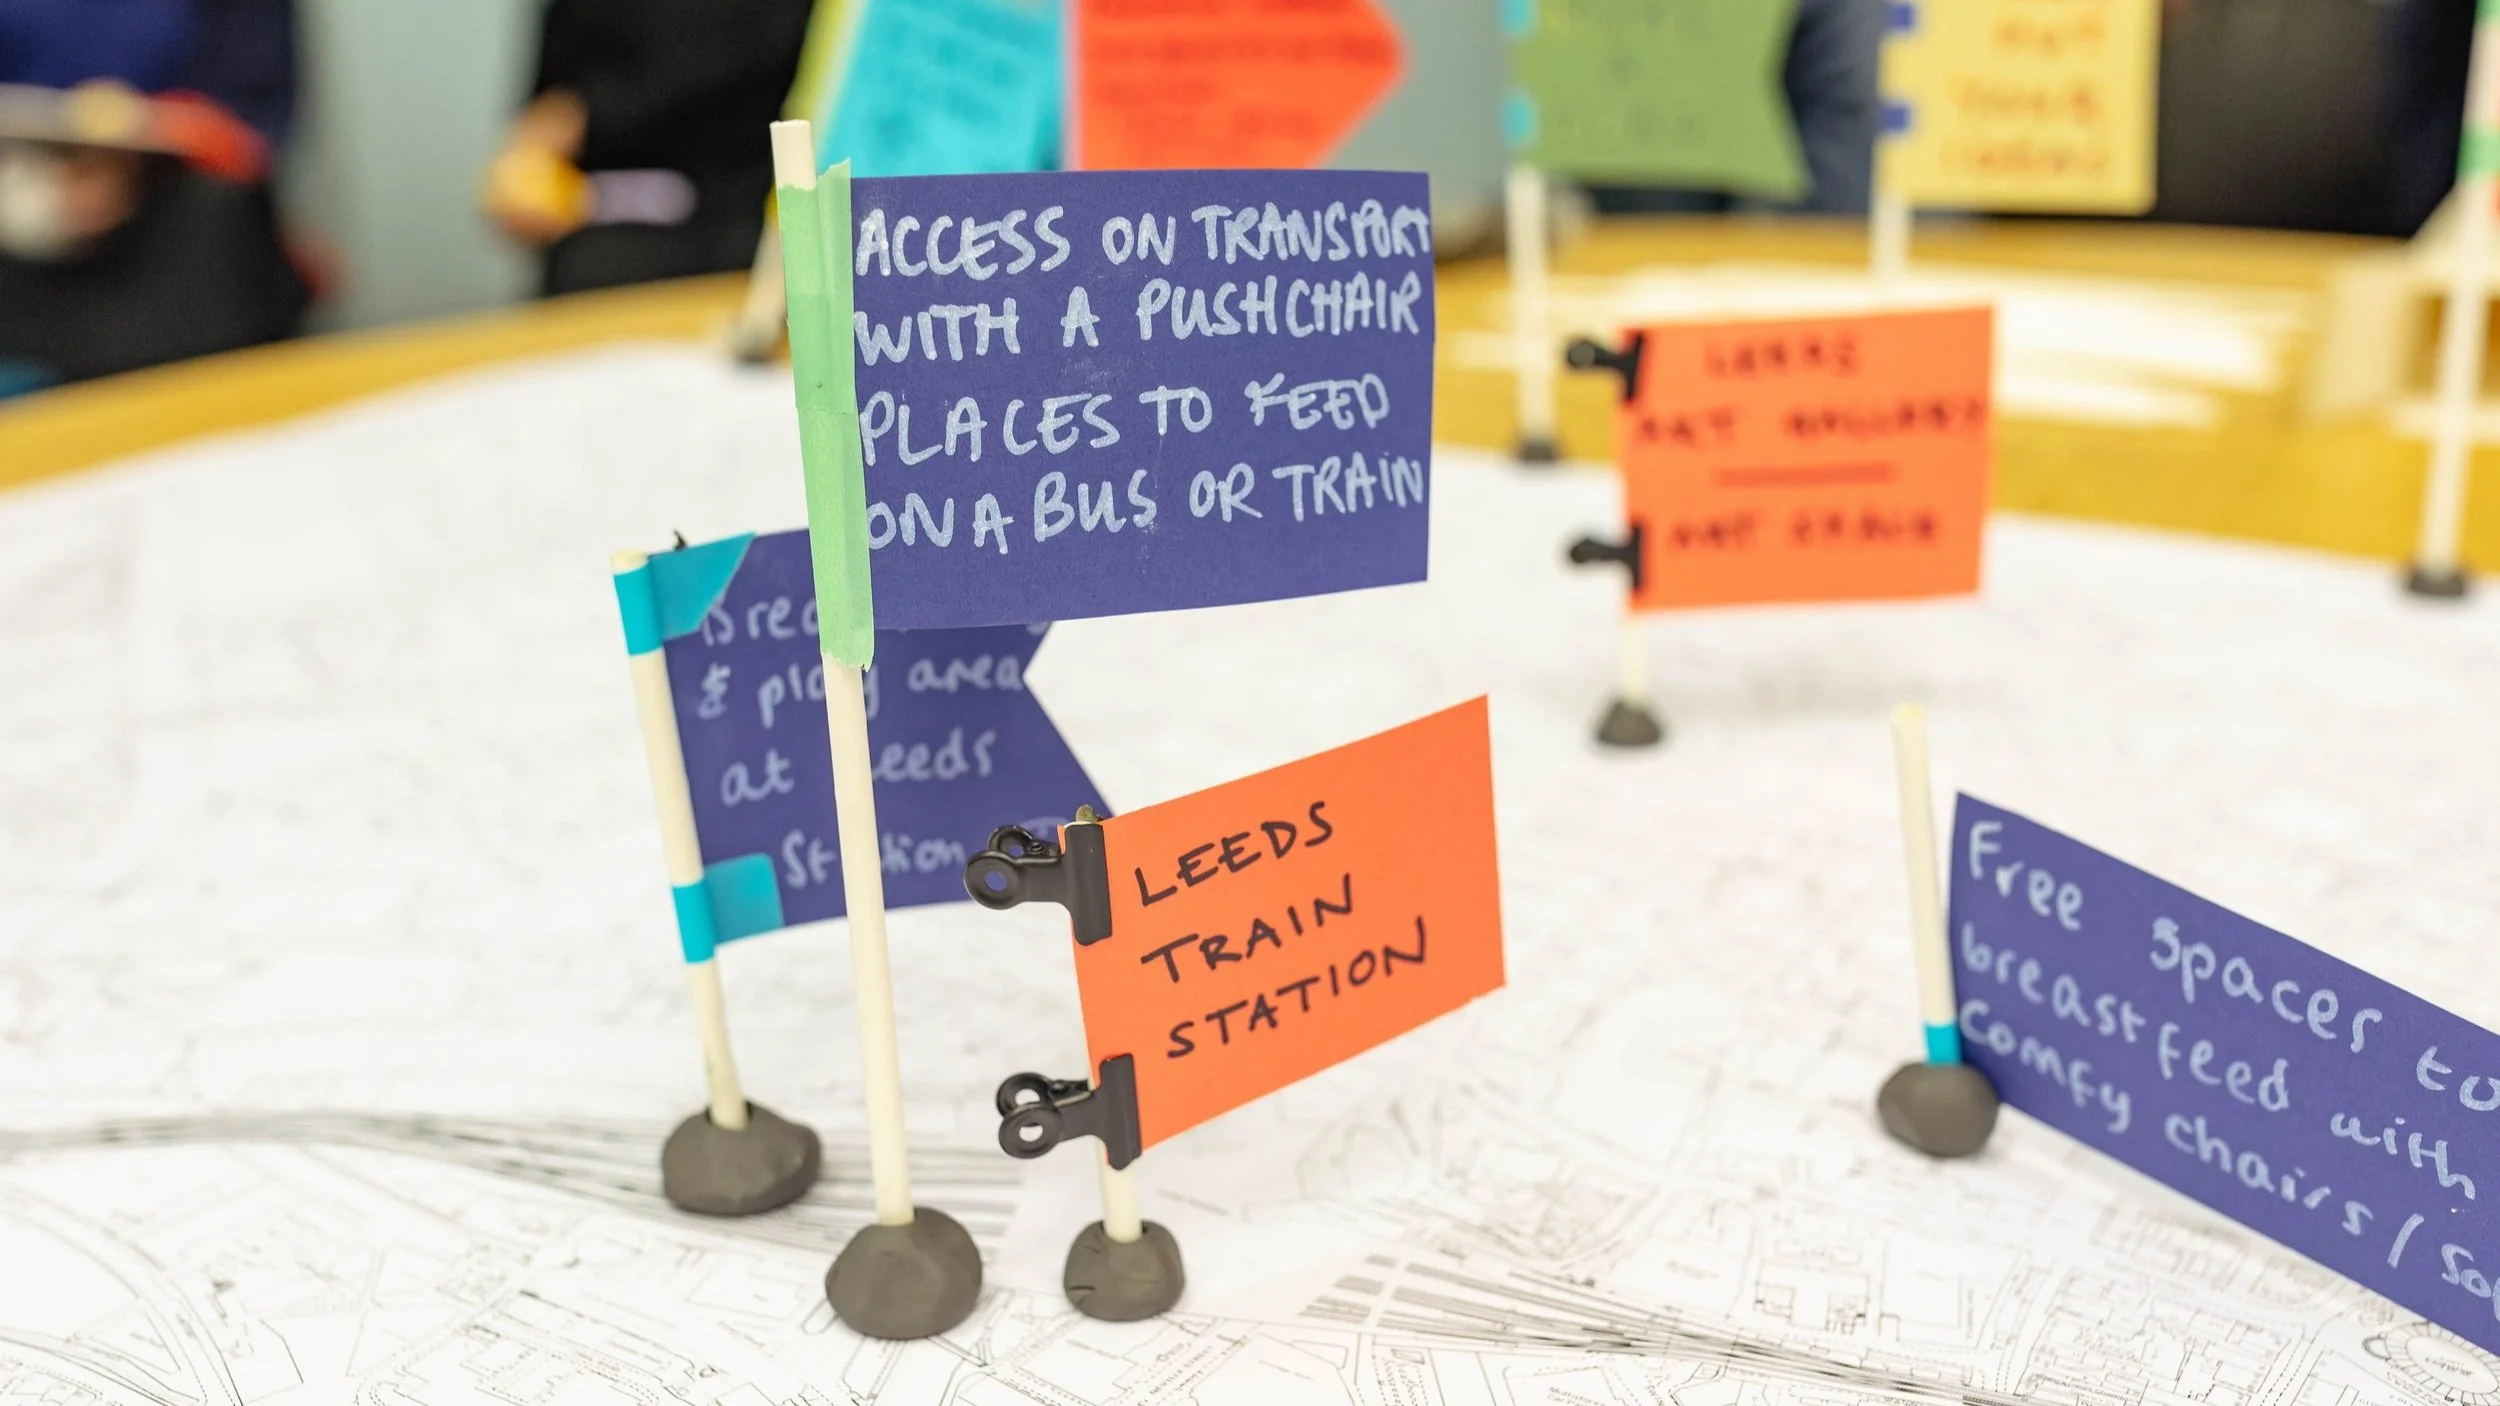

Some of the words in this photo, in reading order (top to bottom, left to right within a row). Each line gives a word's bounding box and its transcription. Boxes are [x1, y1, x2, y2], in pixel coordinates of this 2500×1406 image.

[855, 205, 1071, 280] ACCESS
[1101, 212, 1176, 266] ON
[1191, 199, 1432, 264] TRANSPORT
[854, 297, 1021, 366] WITH
[1061, 286, 1100, 347] A
[1136, 270, 1422, 341] PUSHCHAIR
[858, 390, 1120, 466] PLACES
[1139, 384, 1212, 436] TO
[1244, 373, 1389, 430] FEED
[866, 496, 954, 550] ON
[973, 492, 1014, 554] A
[1034, 469, 1157, 542] BUS
[1189, 462, 1263, 521] OR
[721, 750, 795, 806] at
[872, 727, 996, 782] eeds
[782, 829, 966, 887] Sttion
[1135, 801, 1334, 907] LEEDS
[1969, 821, 2083, 931] Free
[1141, 872, 1353, 983] TRAIN
[1167, 915, 1426, 1058] STATION
